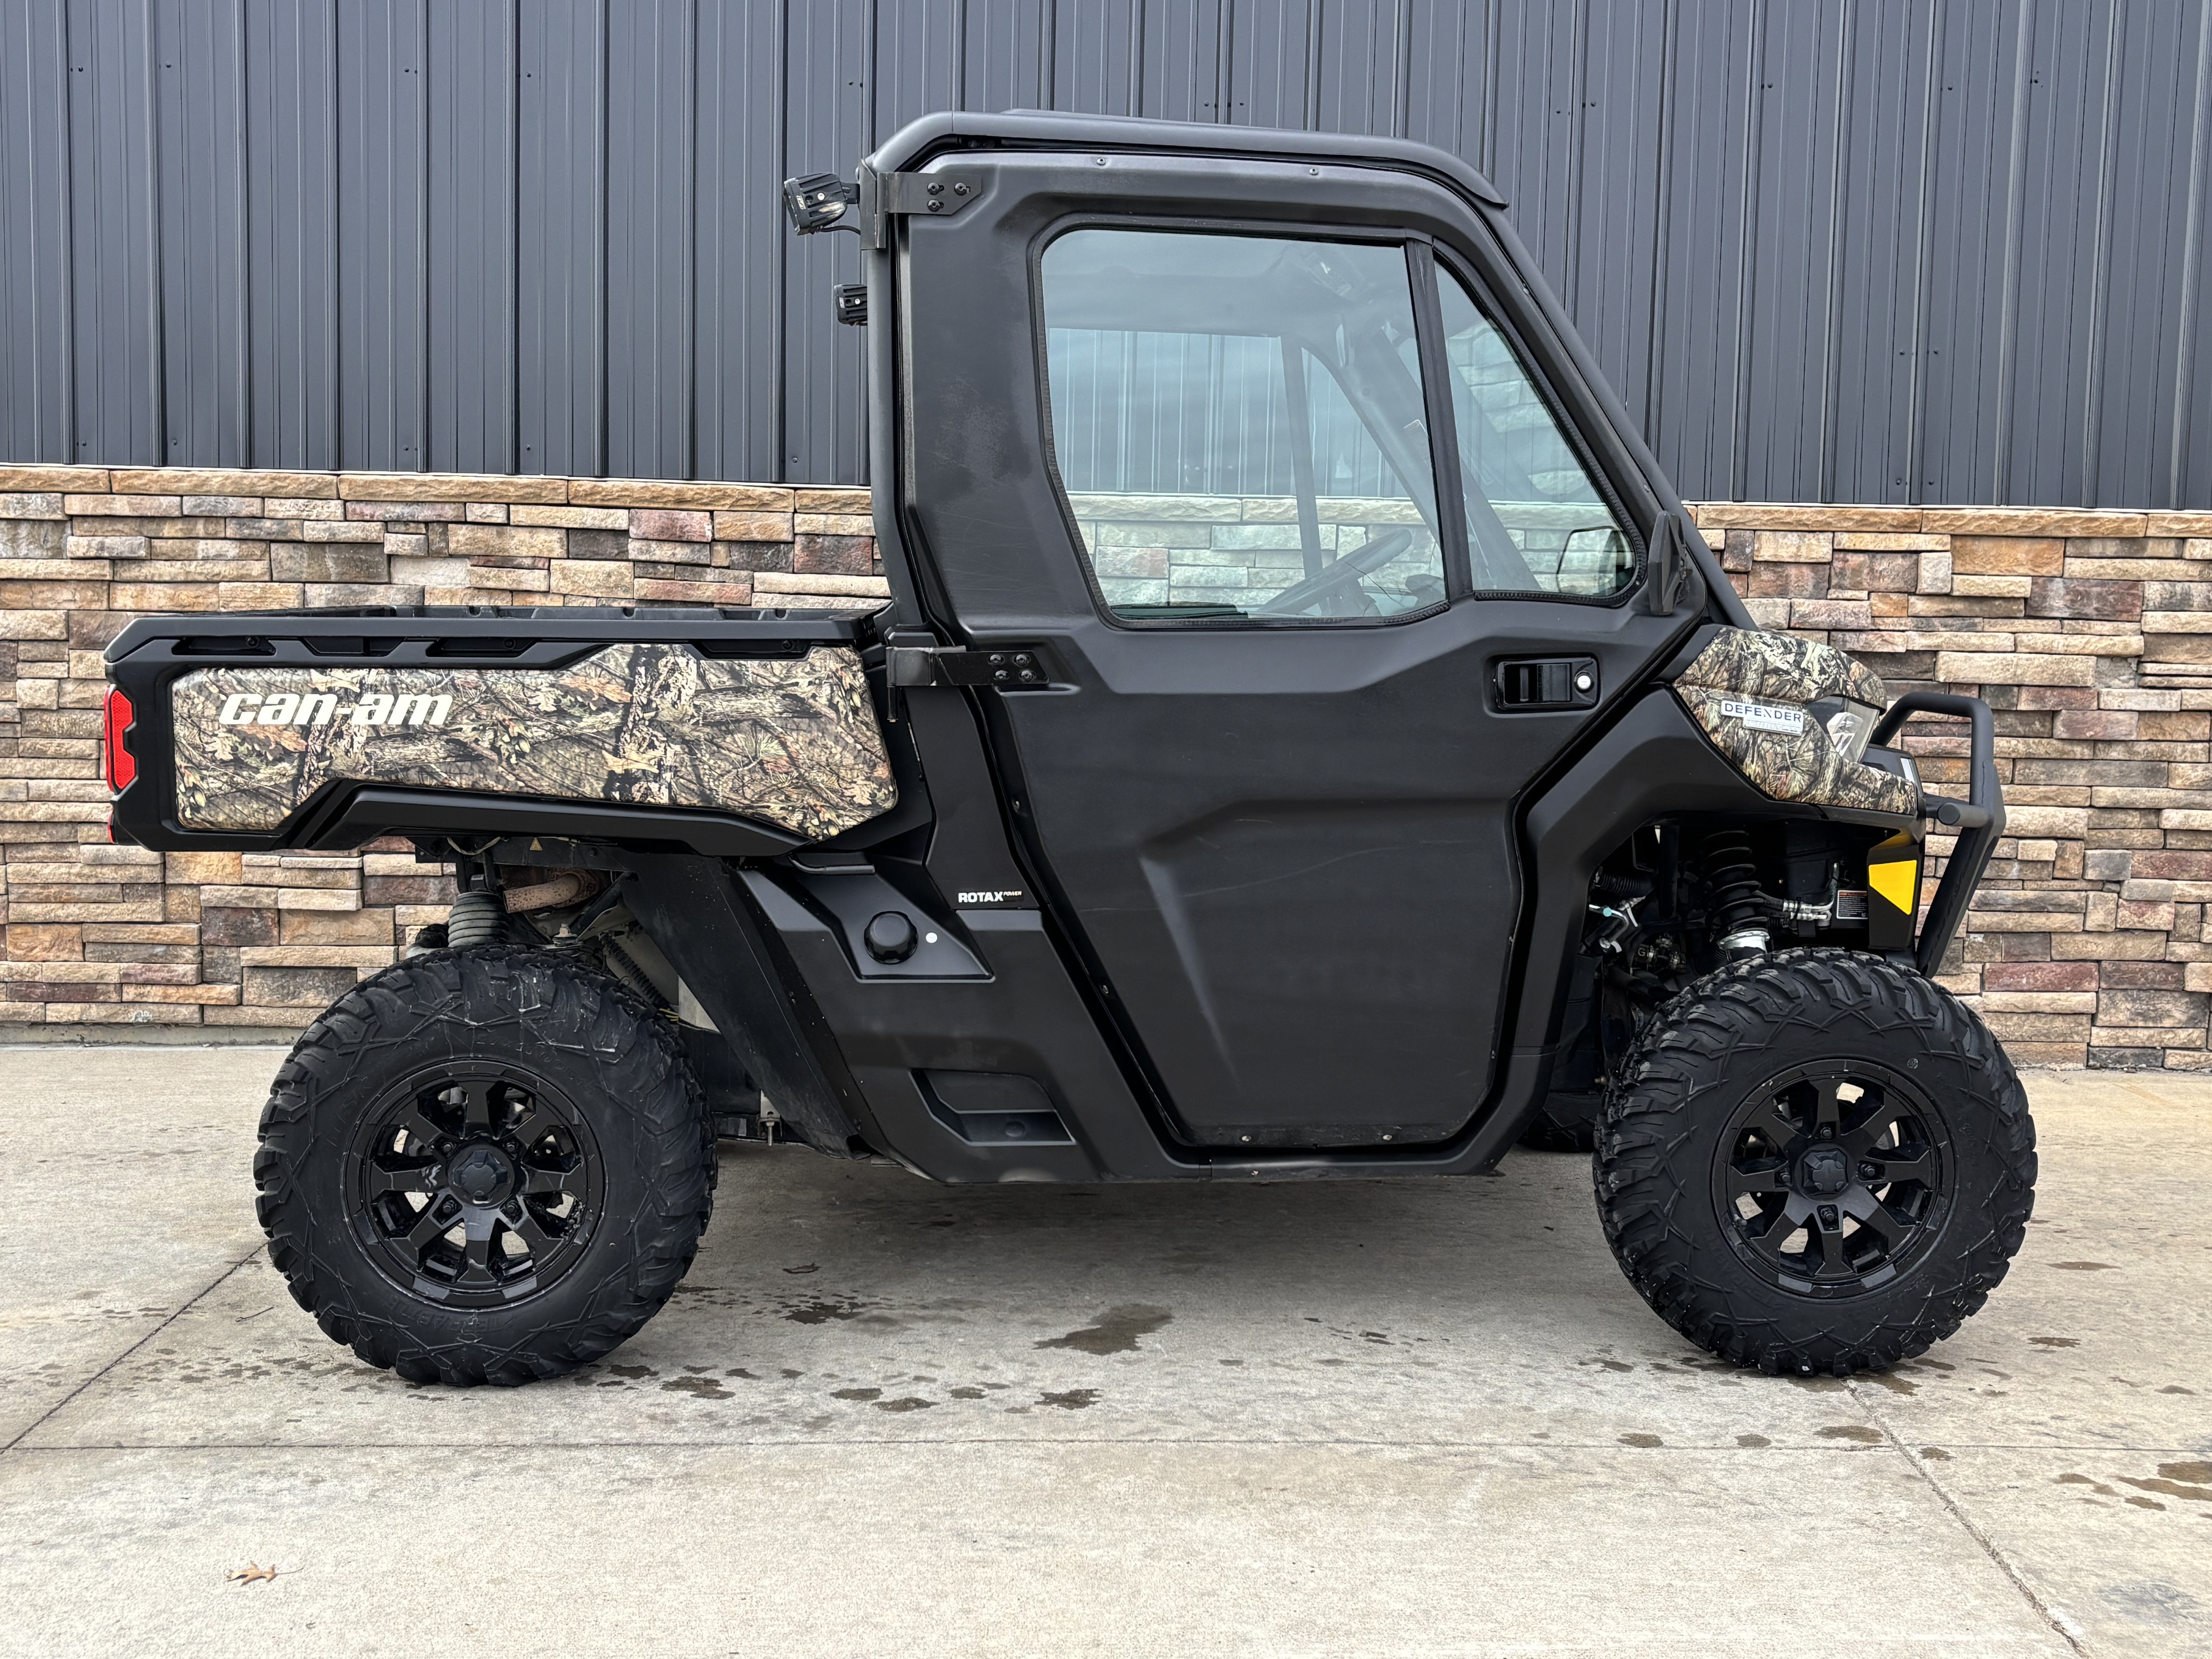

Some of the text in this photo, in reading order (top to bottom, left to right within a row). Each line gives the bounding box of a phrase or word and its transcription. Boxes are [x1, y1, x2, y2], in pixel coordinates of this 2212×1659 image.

[219, 694, 453, 725] can-am
[1724, 703, 1801, 723] DEFENDER
[958, 891, 1003, 903] ROTAX
